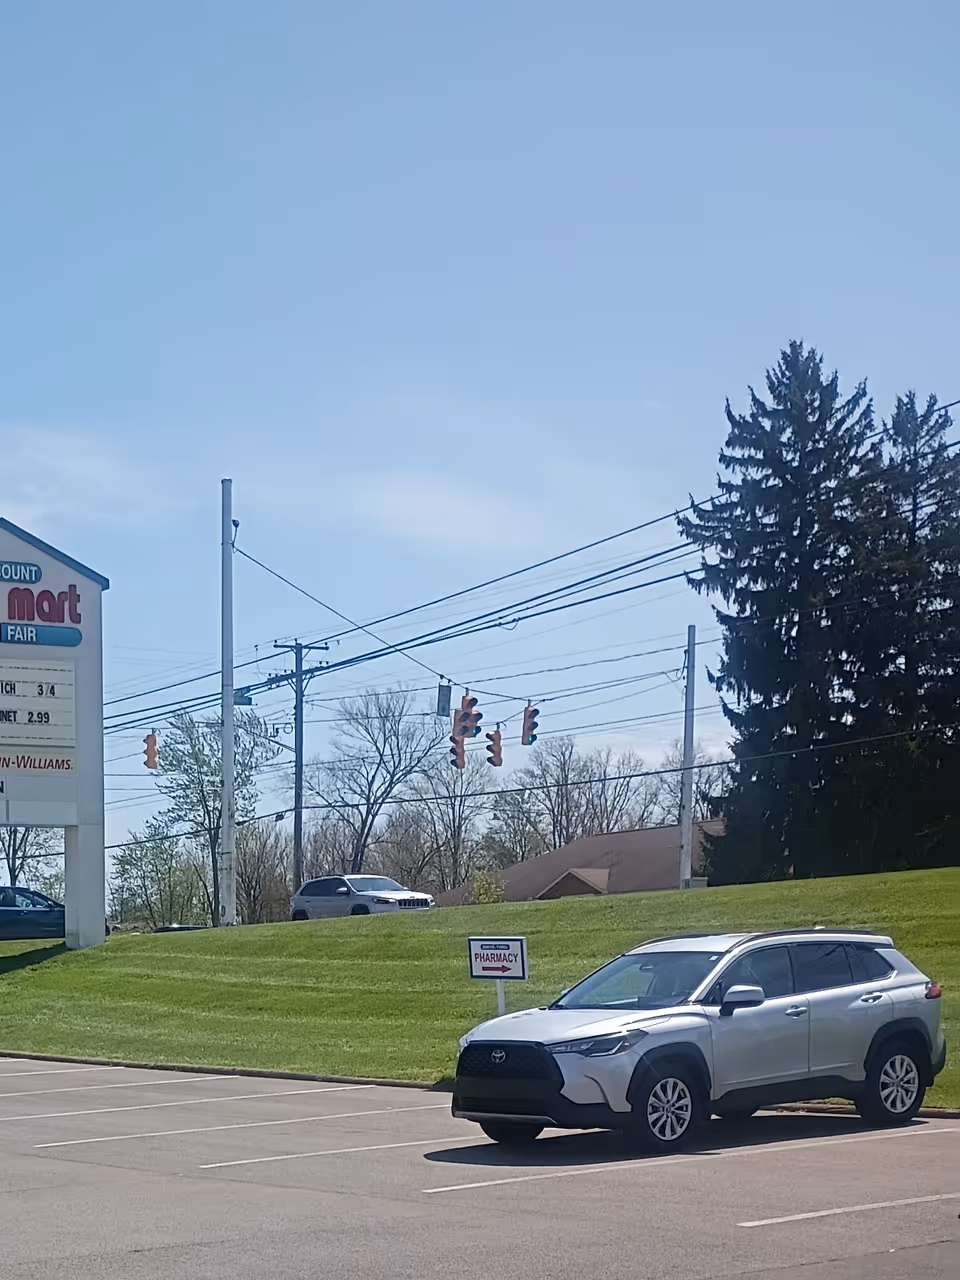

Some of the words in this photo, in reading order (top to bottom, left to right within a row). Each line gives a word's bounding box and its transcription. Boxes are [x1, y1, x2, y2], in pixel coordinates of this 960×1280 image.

[7, 584, 82, 624] mart
[7, 625, 37, 643] FAIR
[27, 711, 50, 724] 2.99
[474, 952, 519, 963] PHARMACY
